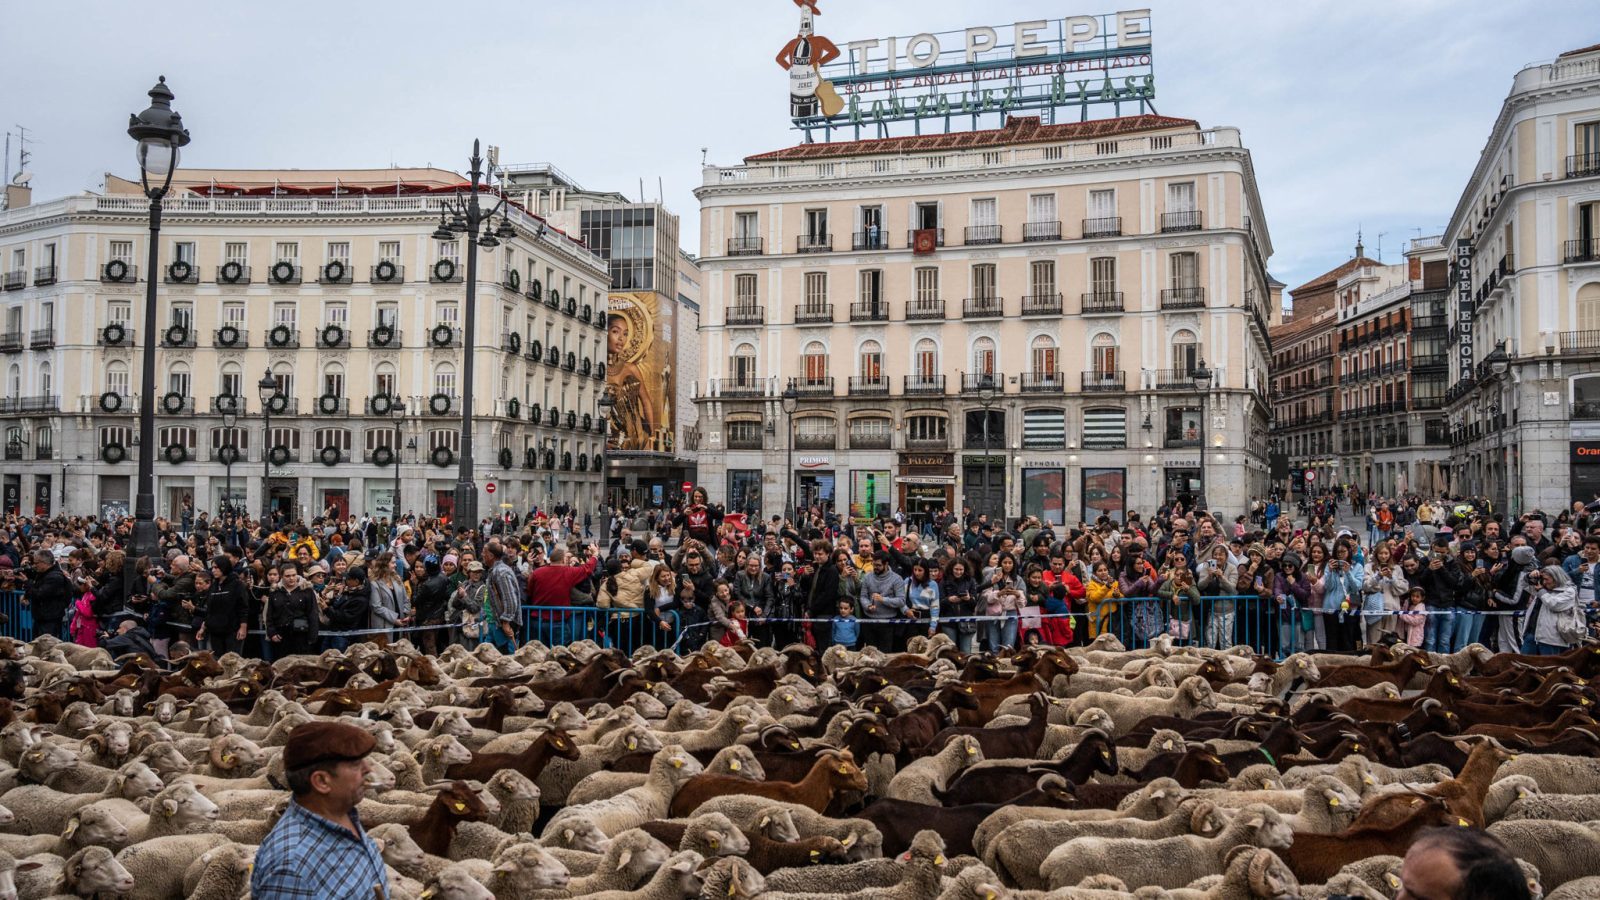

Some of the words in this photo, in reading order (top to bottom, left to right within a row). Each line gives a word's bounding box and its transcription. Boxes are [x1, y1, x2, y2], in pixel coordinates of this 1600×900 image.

[848, 33, 941, 75] TIO
[966, 8, 1152, 63] PEPE
[844, 82, 878, 95] SOL
[884, 78, 903, 91] DE
[913, 68, 1008, 87] ANDALUCIA
[1016, 54, 1151, 78] EMBOTELLADO
[849, 85, 1016, 123] GONZALEZ
[1458, 246, 1471, 302] HOTEL
[1461, 311, 1473, 380] EUROPA
[799, 456, 829, 464] PRIMOR
[908, 456, 944, 465] PALAZZO
